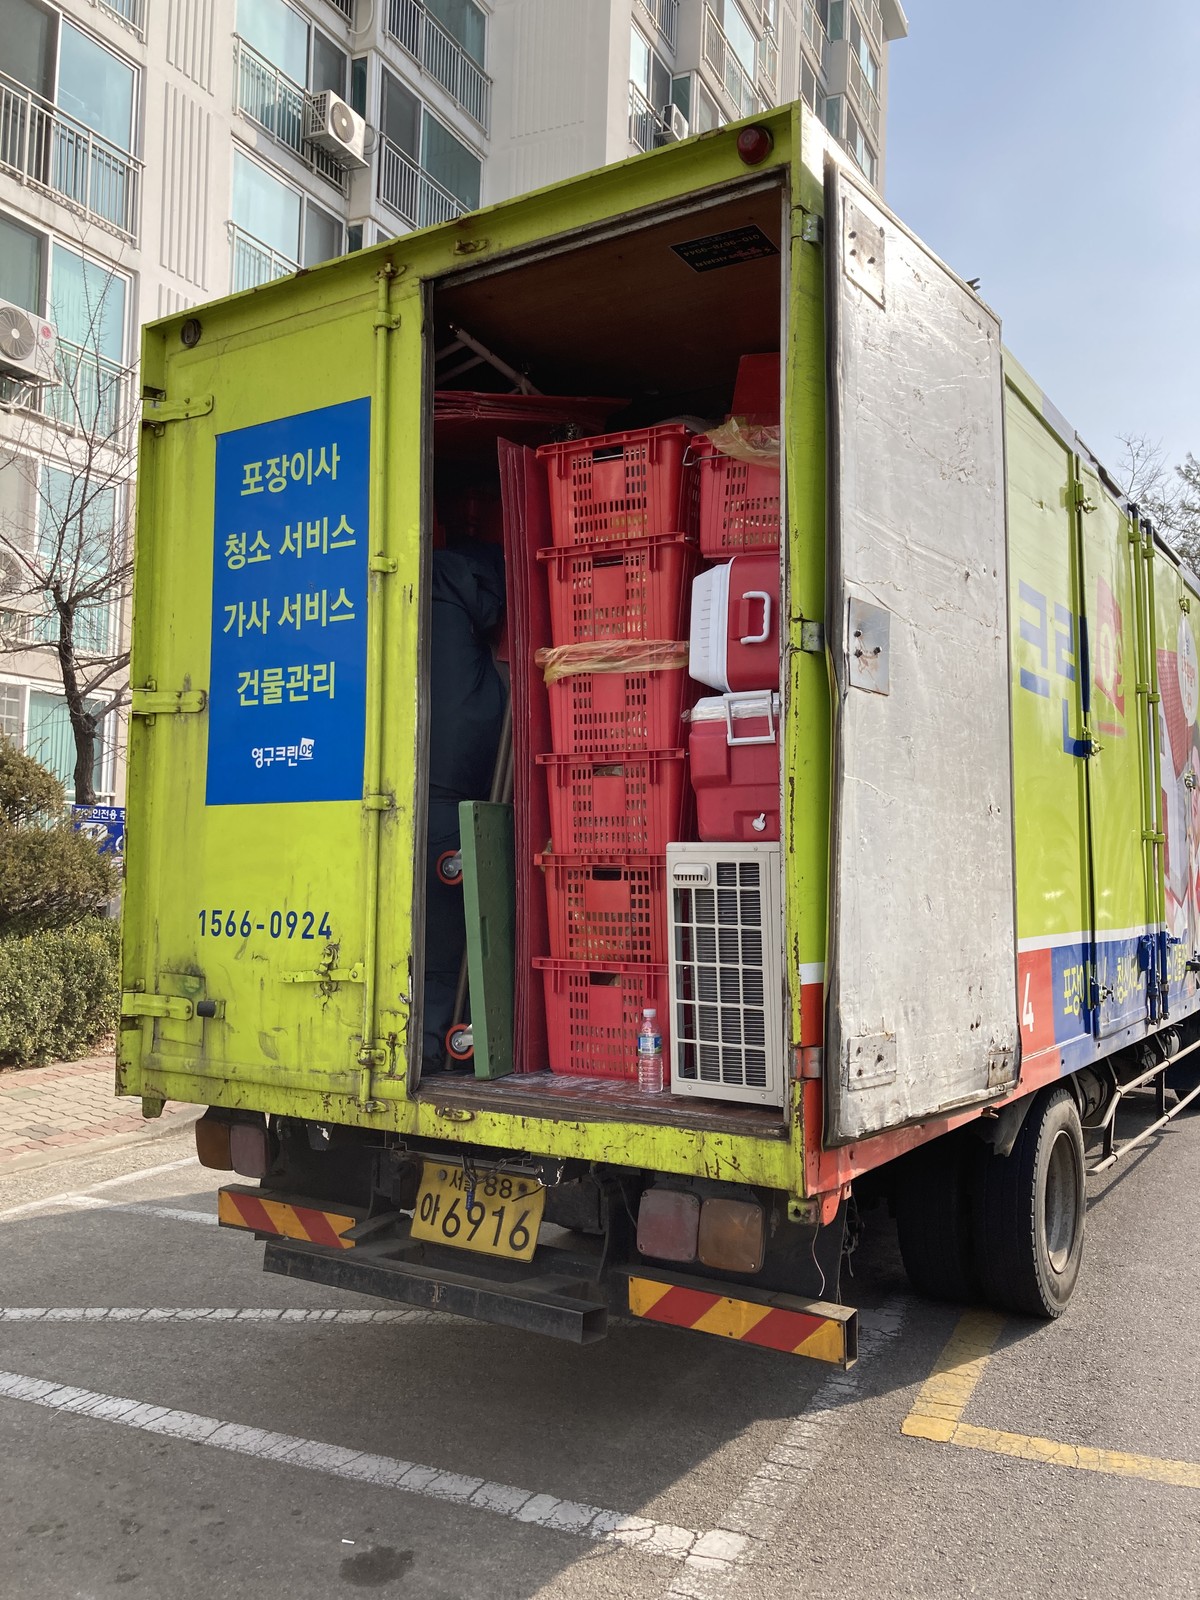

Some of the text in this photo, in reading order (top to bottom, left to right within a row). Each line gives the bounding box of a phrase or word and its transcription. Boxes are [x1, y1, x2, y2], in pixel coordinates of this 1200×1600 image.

[240, 442, 341, 497] 포장이사
[224, 514, 357, 570] 청소 서비스
[223, 587, 356, 638] 가사 서비스
[236, 661, 336, 707] 건물관리
[198, 909, 332, 940] 1566-0924
[483, 1175, 513, 1200] 88
